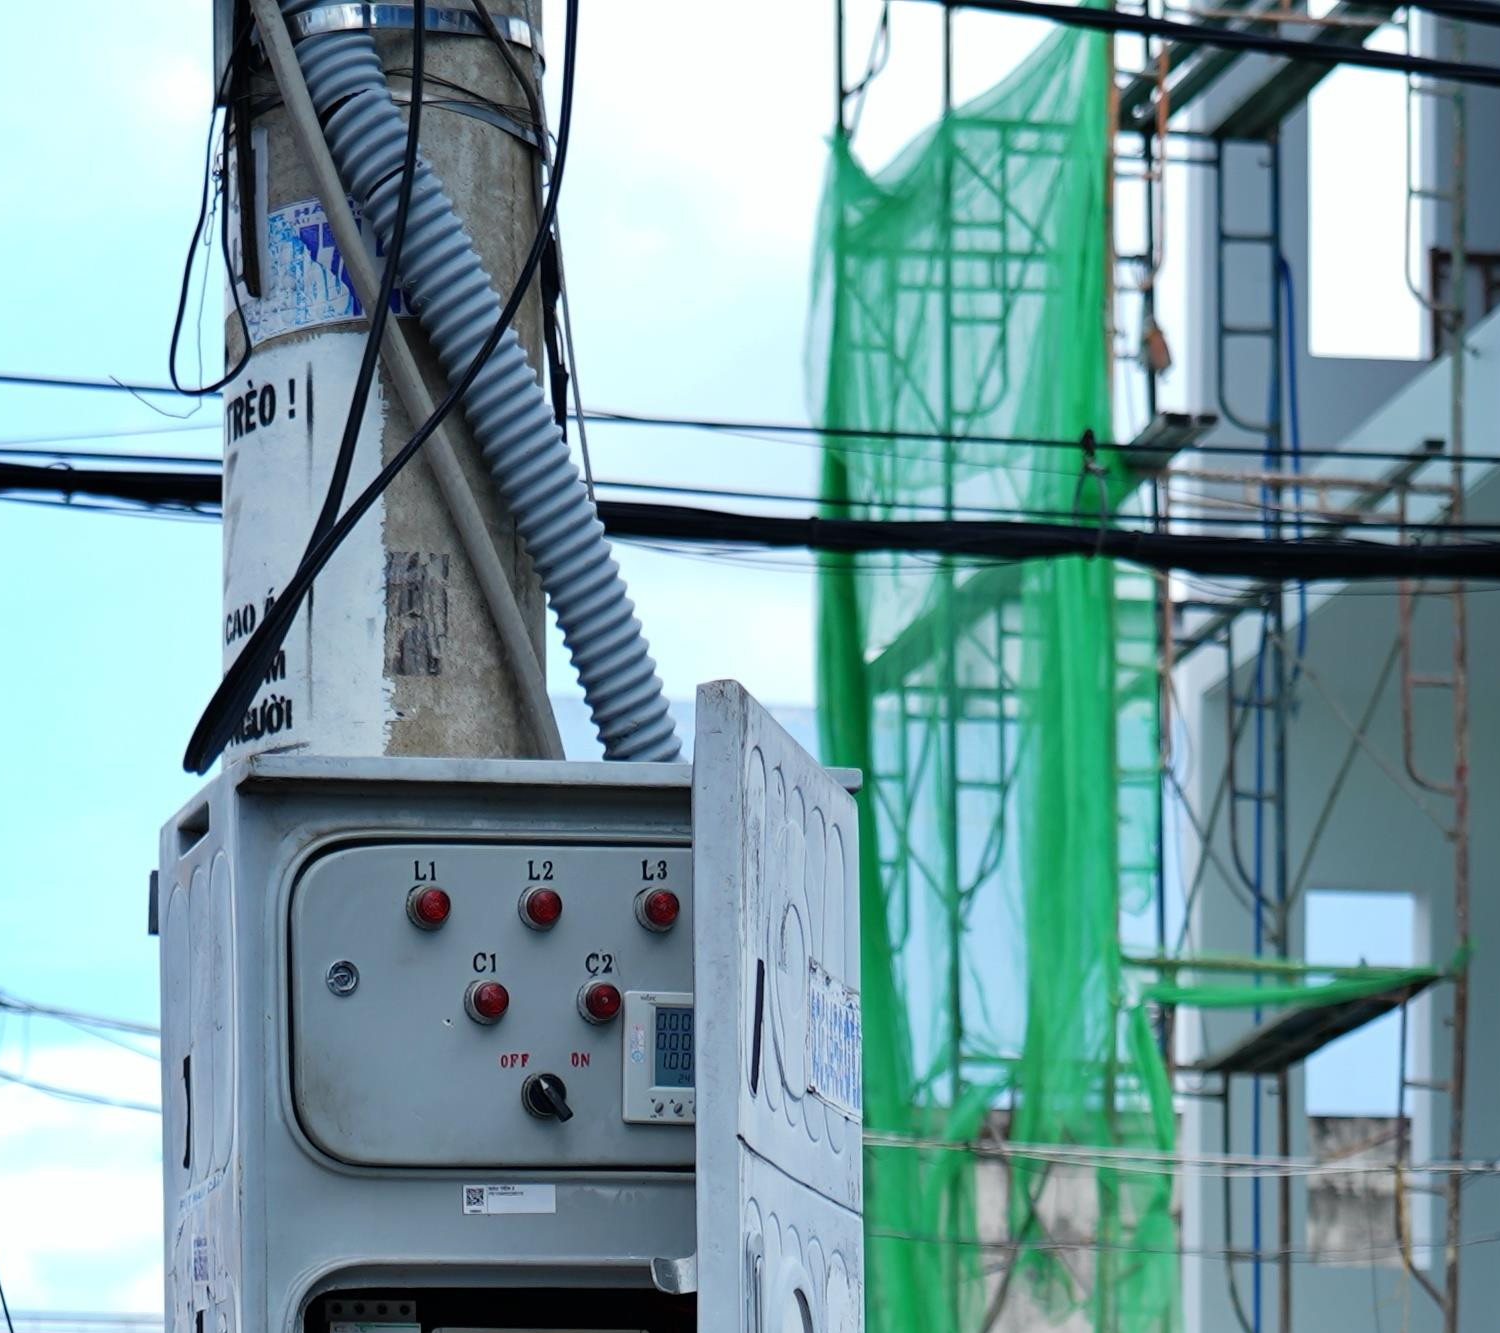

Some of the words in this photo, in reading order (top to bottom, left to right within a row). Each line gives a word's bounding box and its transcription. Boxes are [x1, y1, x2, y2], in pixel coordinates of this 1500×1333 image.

[227, 379, 276, 446] TRÈO
[226, 604, 256, 646] CAO
[414, 860, 437, 881] L1
[528, 860, 554, 881] L2
[641, 859, 668, 881] L3
[473, 952, 497, 973] C1
[585, 953, 613, 974] C2
[501, 1053, 530, 1068] OFF
[571, 1052, 590, 1068] ON
